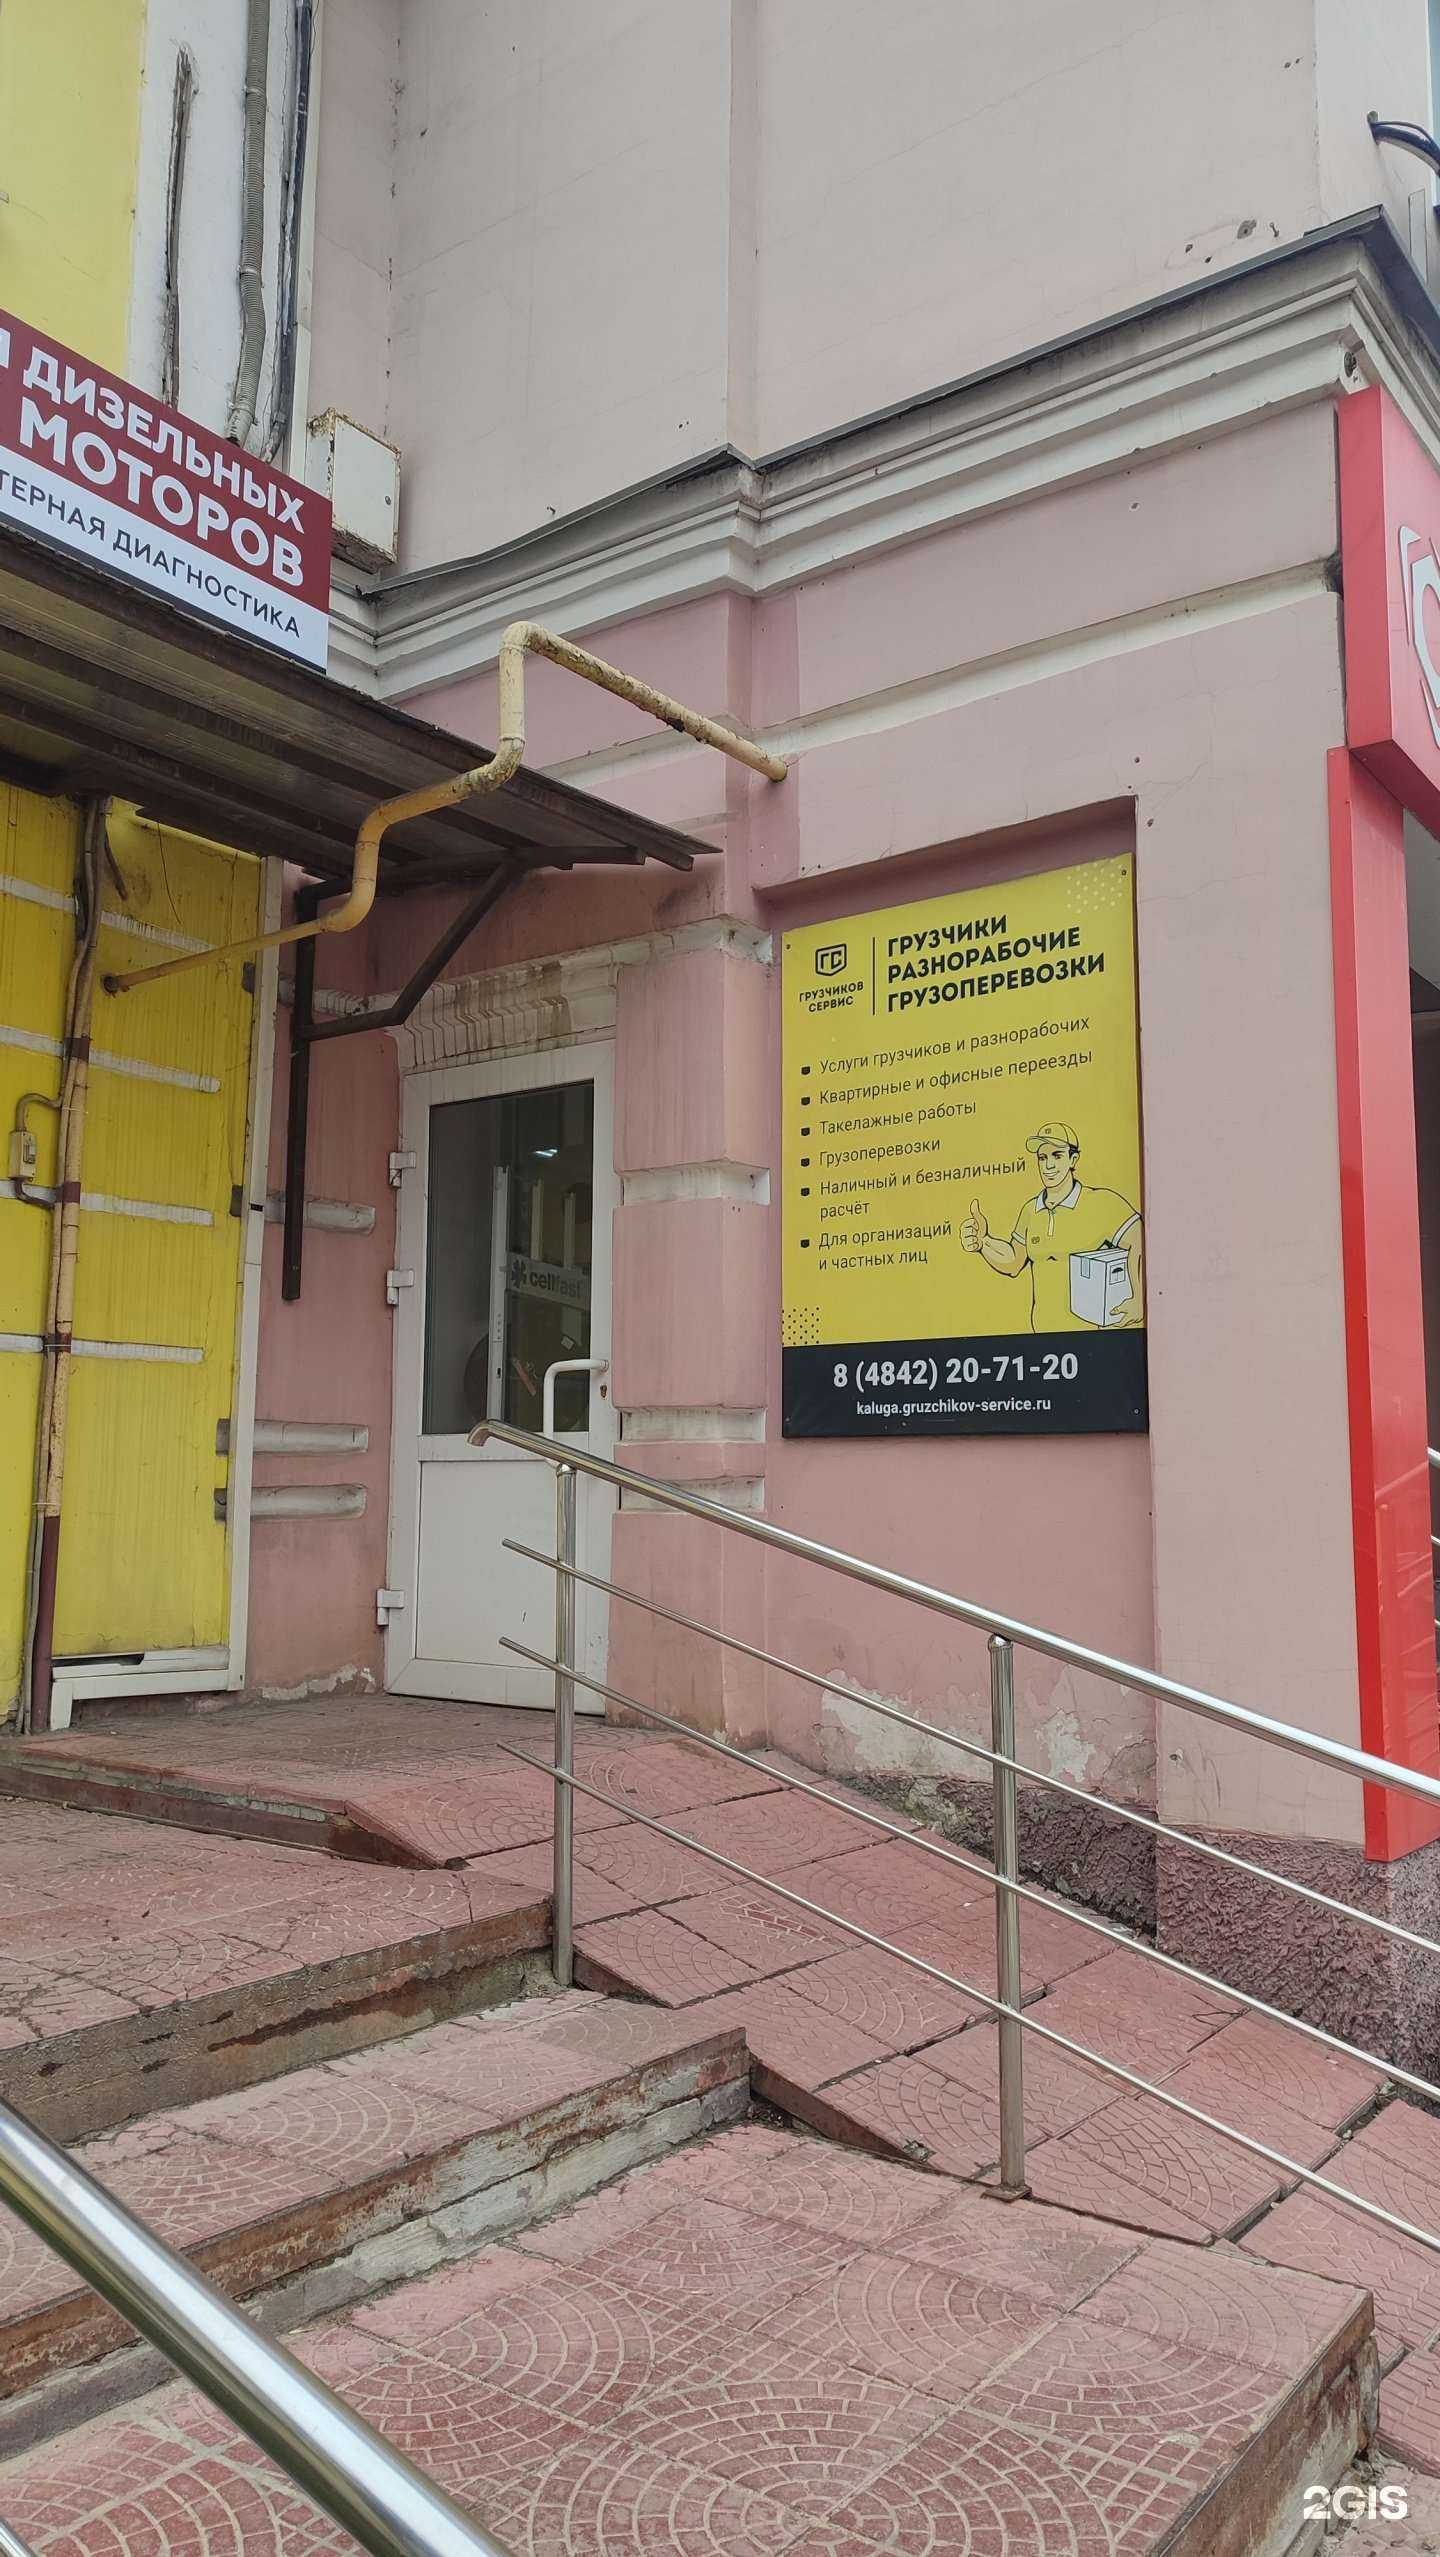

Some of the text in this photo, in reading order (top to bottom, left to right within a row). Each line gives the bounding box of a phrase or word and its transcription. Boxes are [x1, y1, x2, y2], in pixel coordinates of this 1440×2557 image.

[23, 346, 305, 533] ДИЗЕЛЬНЫХ
[19, 396, 303, 586] МОТОРОВ
[113, 529, 300, 638] ДИАГНОСТИКА
[888, 914, 1007, 957] ГРУЗЧИКИ
[888, 926, 1080, 984] РАЗНОРАБОЧИЕ
[799, 980, 864, 1003] ГРУЗЧИКОВ
[888, 953, 1105, 1012] ГРУЗОПЕРЕВОЗКИ
[808, 995, 854, 1013] СЕРВИС
[820, 1016, 1090, 1074] Услуги грузчиков и разнорабочих
[820, 1051, 1092, 1105] Квартирные и офисные переезды
[820, 1100, 976, 1135] Такелажные работы
[819, 1138, 940, 1168] Грузоперевозки
[820, 1157, 1026, 1196] Наличный и безналичный
[820, 1200, 870, 1221] расчёт
[818, 1221, 951, 1250] Для организаций
[819, 1250, 928, 1270] и частных лиц
[833, 1353, 1079, 1392] 8 (4842) 20-71-20
[856, 1397, 1051, 1417] kaluga.gruzchikov-service.ru
